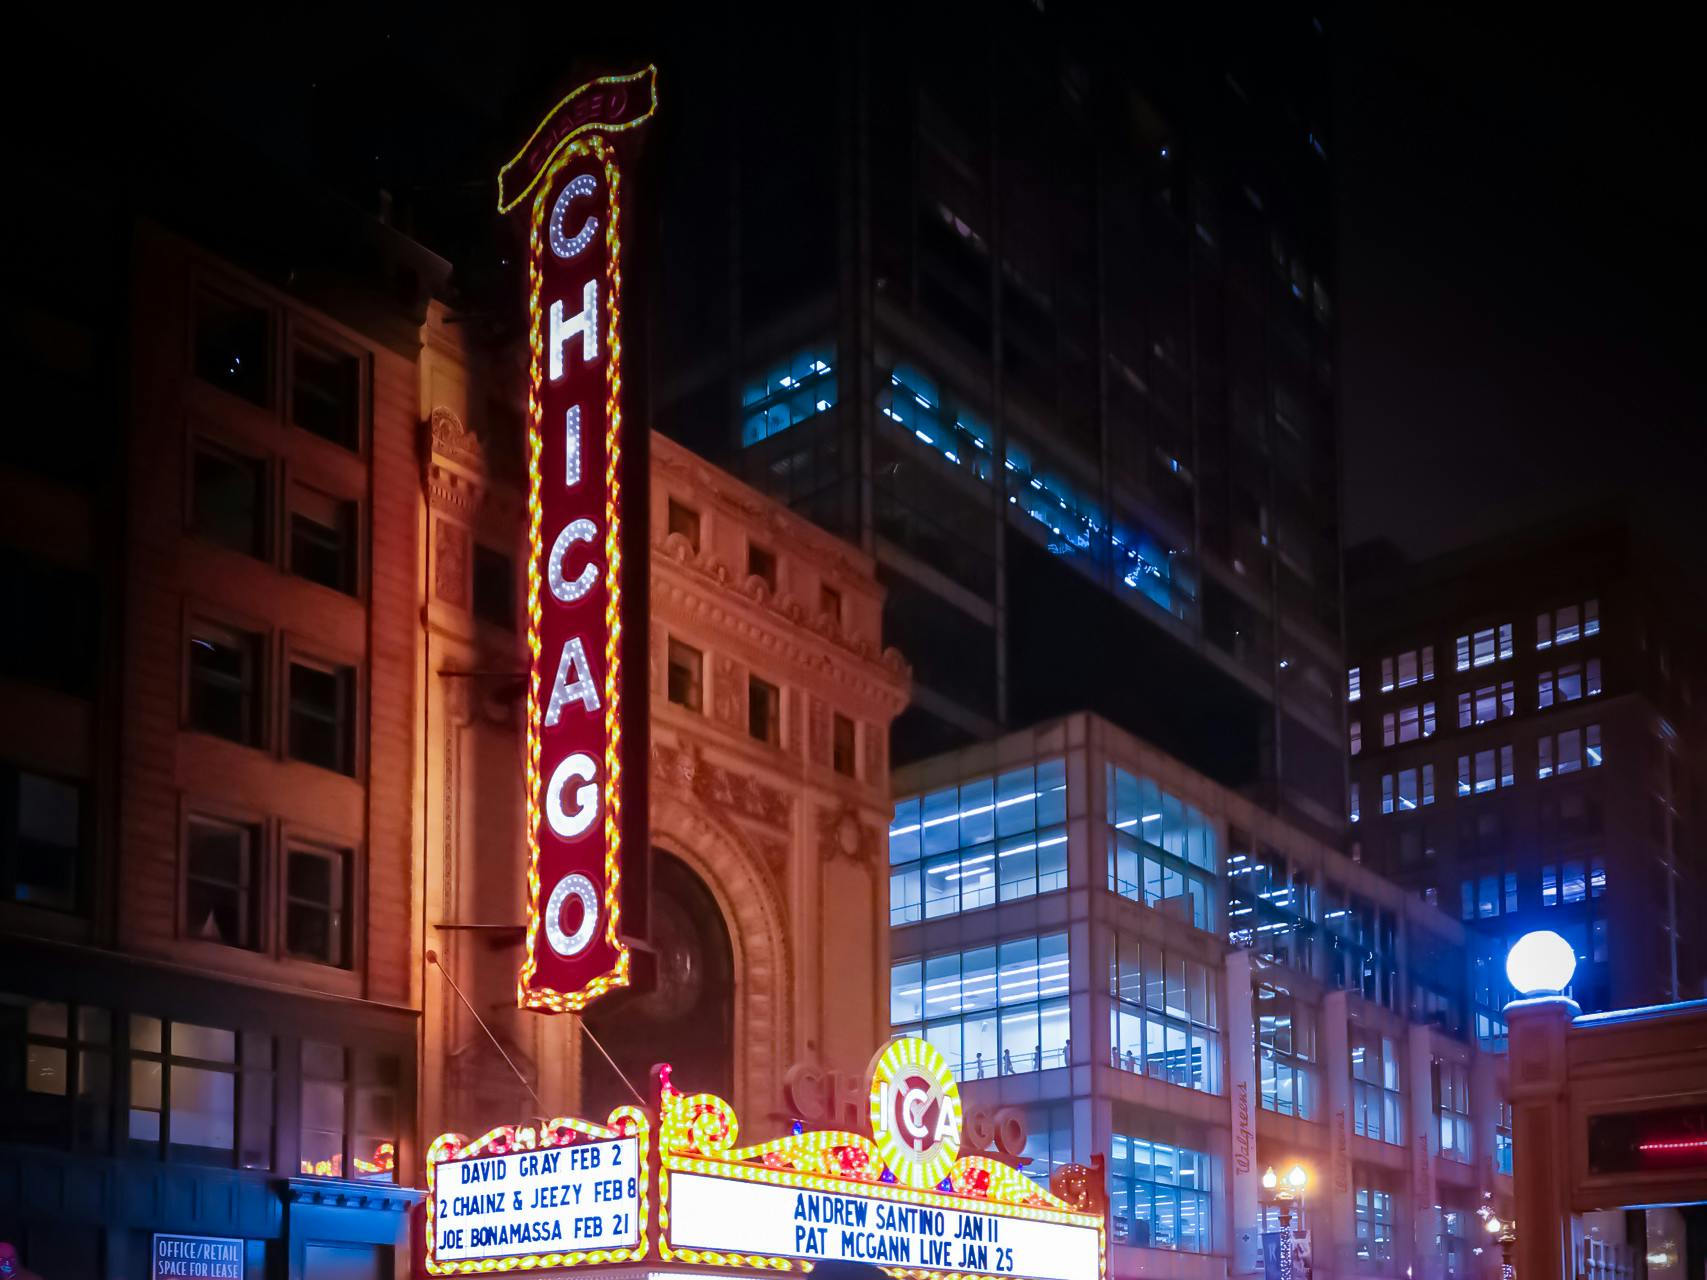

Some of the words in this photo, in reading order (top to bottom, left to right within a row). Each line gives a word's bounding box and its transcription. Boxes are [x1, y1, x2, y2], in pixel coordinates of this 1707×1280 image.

[544, 174, 602, 957] CHICAGO
[785, 1063, 1028, 1157] CHICAGO
[1234, 1081, 1254, 1176] Walgreens
[462, 1161, 506, 1184] DAVID
[520, 1152, 561, 1177] GRAY
[571, 1147, 600, 1170] FEB
[612, 1145, 621, 1165] 2
[440, 1200, 447, 1218] 2
[454, 1193, 504, 1216] CHAINZ
[513, 1191, 522, 1210] &
[531, 1184, 582, 1209] JEEZY
[595, 1180, 622, 1203] FEB
[628, 1178, 636, 1198] 8
[794, 1194, 867, 1225] ANDREW
[876, 1205, 944, 1236] SANTINO
[955, 1219, 983, 1242] JAN
[988, 1220, 998, 1243] 11
[159, 1240, 239, 1262] OFFICE/RETAIL
[439, 1230, 463, 1250] JOE
[471, 1220, 561, 1246] BONAMASSA
[575, 1217, 602, 1238] FEB
[613, 1214, 628, 1234] 21
[795, 1226, 827, 1255] PAT
[842, 1232, 910, 1262] MCGANN
[920, 1241, 952, 1267] LIVE
[959, 1244, 988, 1269] JAN
[996, 1248, 1013, 1271] 25
[158, 1260, 187, 1276] SPACE
[190, 1262, 208, 1277] FOR
[211, 1264, 239, 1278] LEASE
